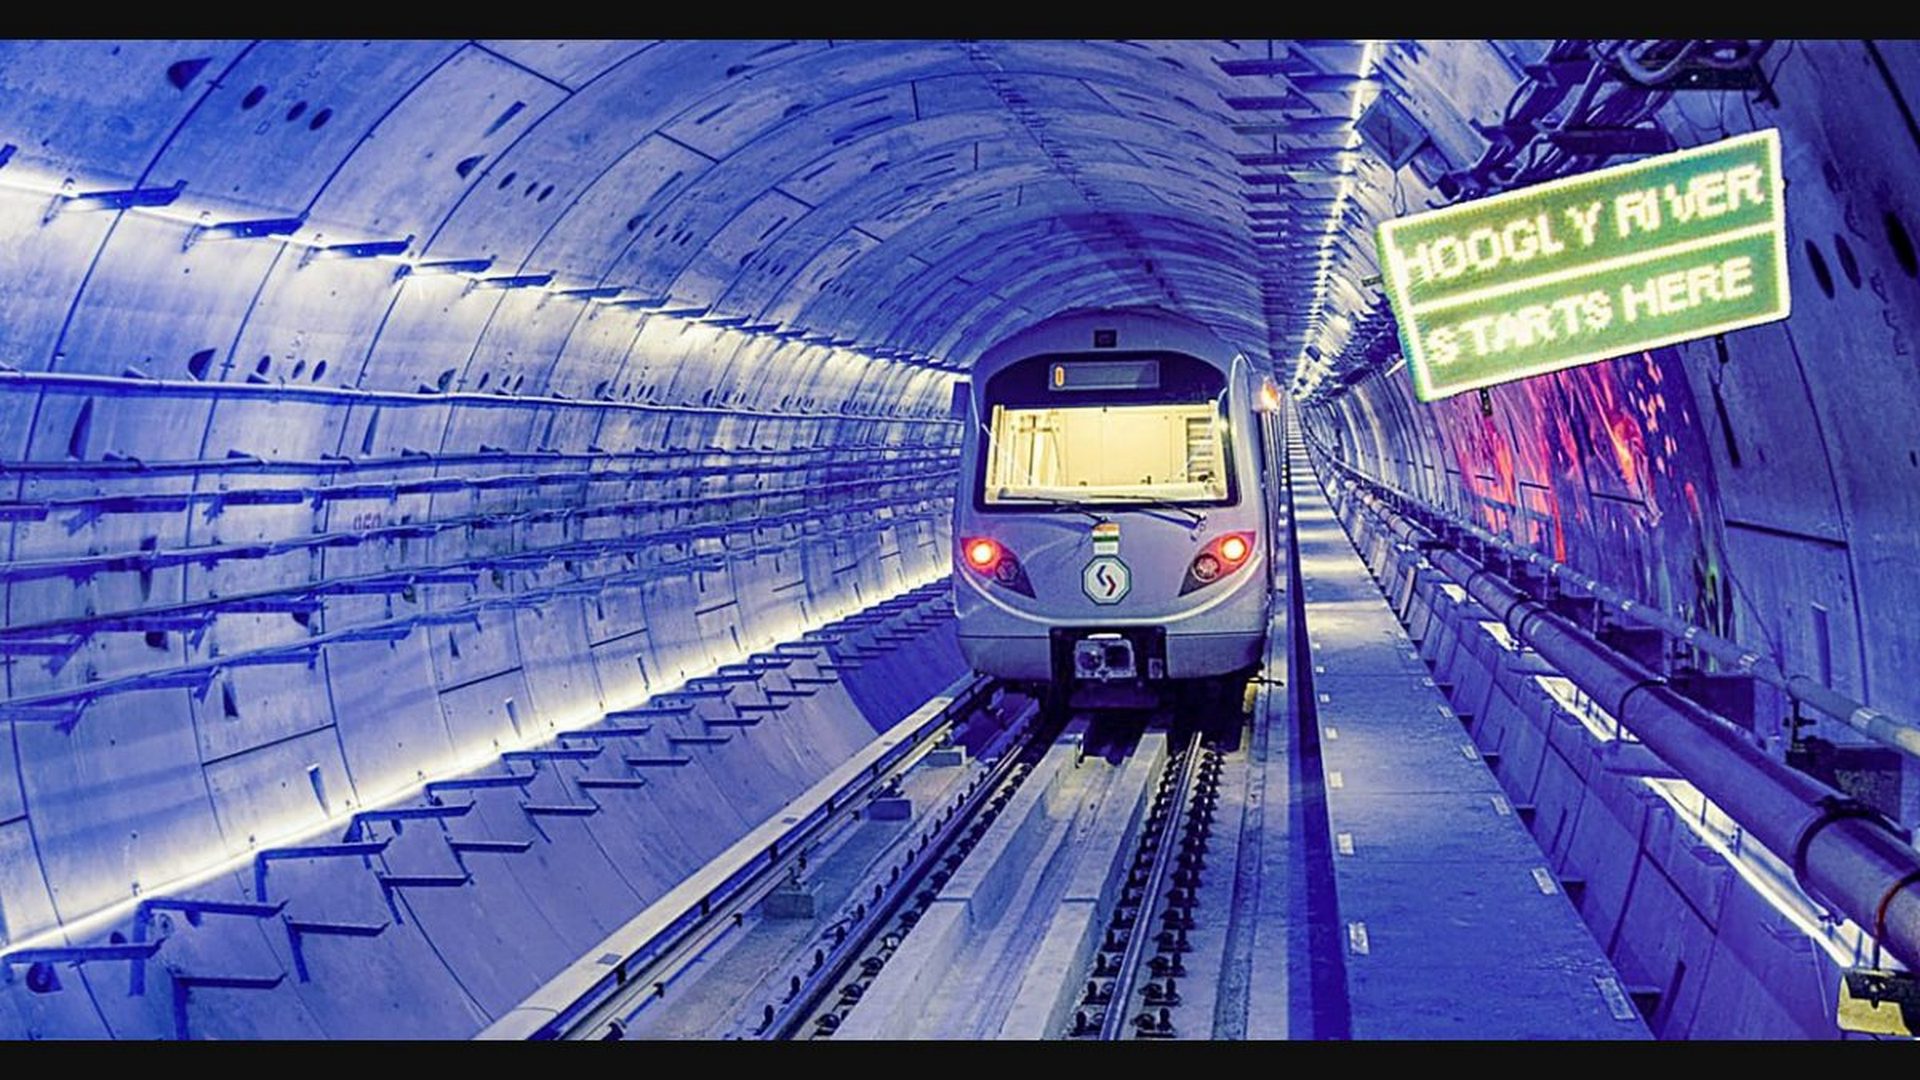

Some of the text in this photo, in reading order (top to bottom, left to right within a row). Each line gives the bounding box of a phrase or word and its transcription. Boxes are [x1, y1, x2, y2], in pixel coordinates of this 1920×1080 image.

[1395, 163, 1763, 283] HOOGLY RIVER
[1428, 257, 1754, 365] STARTS HERE
